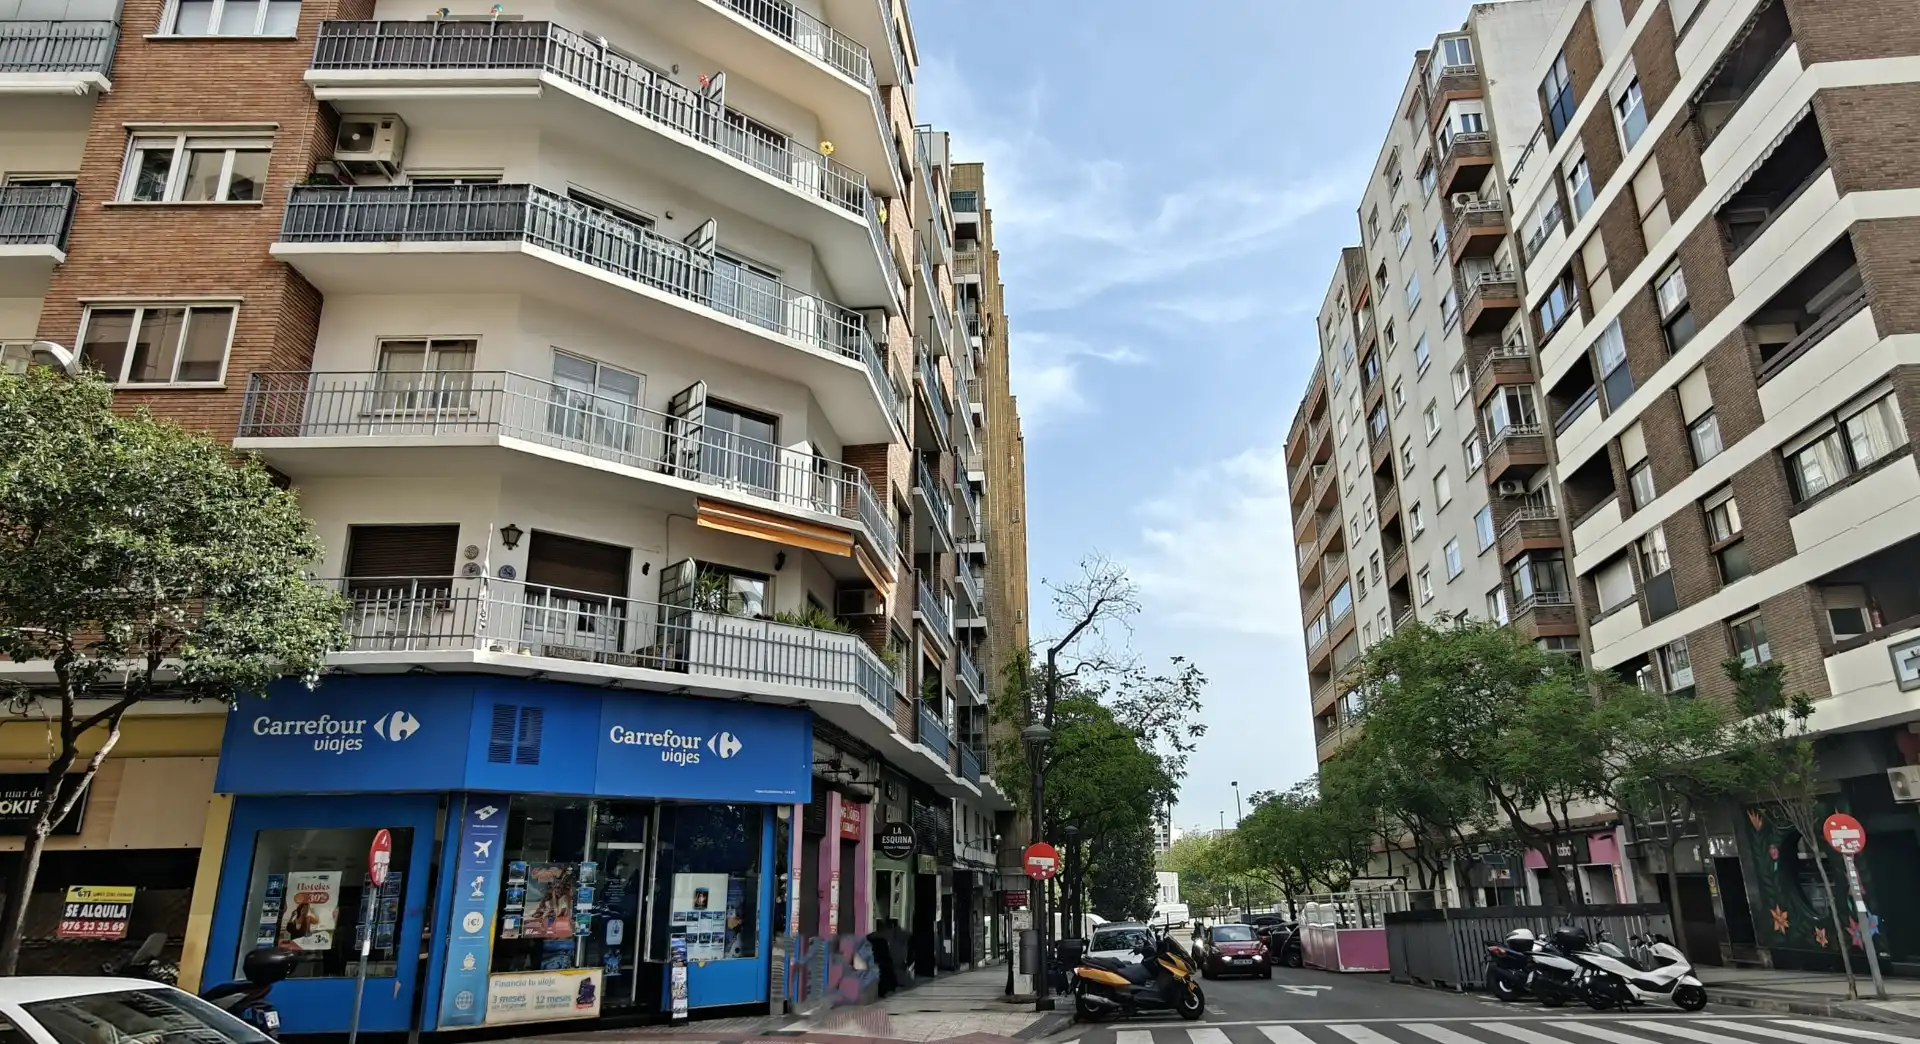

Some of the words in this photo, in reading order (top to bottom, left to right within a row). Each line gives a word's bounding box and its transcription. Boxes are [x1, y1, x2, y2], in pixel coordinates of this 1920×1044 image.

[253, 714, 367, 736] Carrefour
[609, 725, 702, 749] Carrefour
[313, 735, 363, 755] viajes
[661, 749, 700, 767] viajes
[30, 787, 43, 798] de
[893, 826, 902, 835] LA
[881, 835, 913, 844] ESQUINA
[296, 882, 331, 891] Hoteles
[65, 903, 80, 918] SE
[80, 904, 127, 918] ALQUILA
[62, 921, 80, 931] 976
[82, 922, 95, 931] 23
[97, 922, 110, 931] 35
[112, 922, 125, 931] 69
[528, 978, 536, 986] tu
[499, 995, 526, 1004] meses
[535, 995, 546, 1004] 12
[546, 995, 572, 1003] meses
